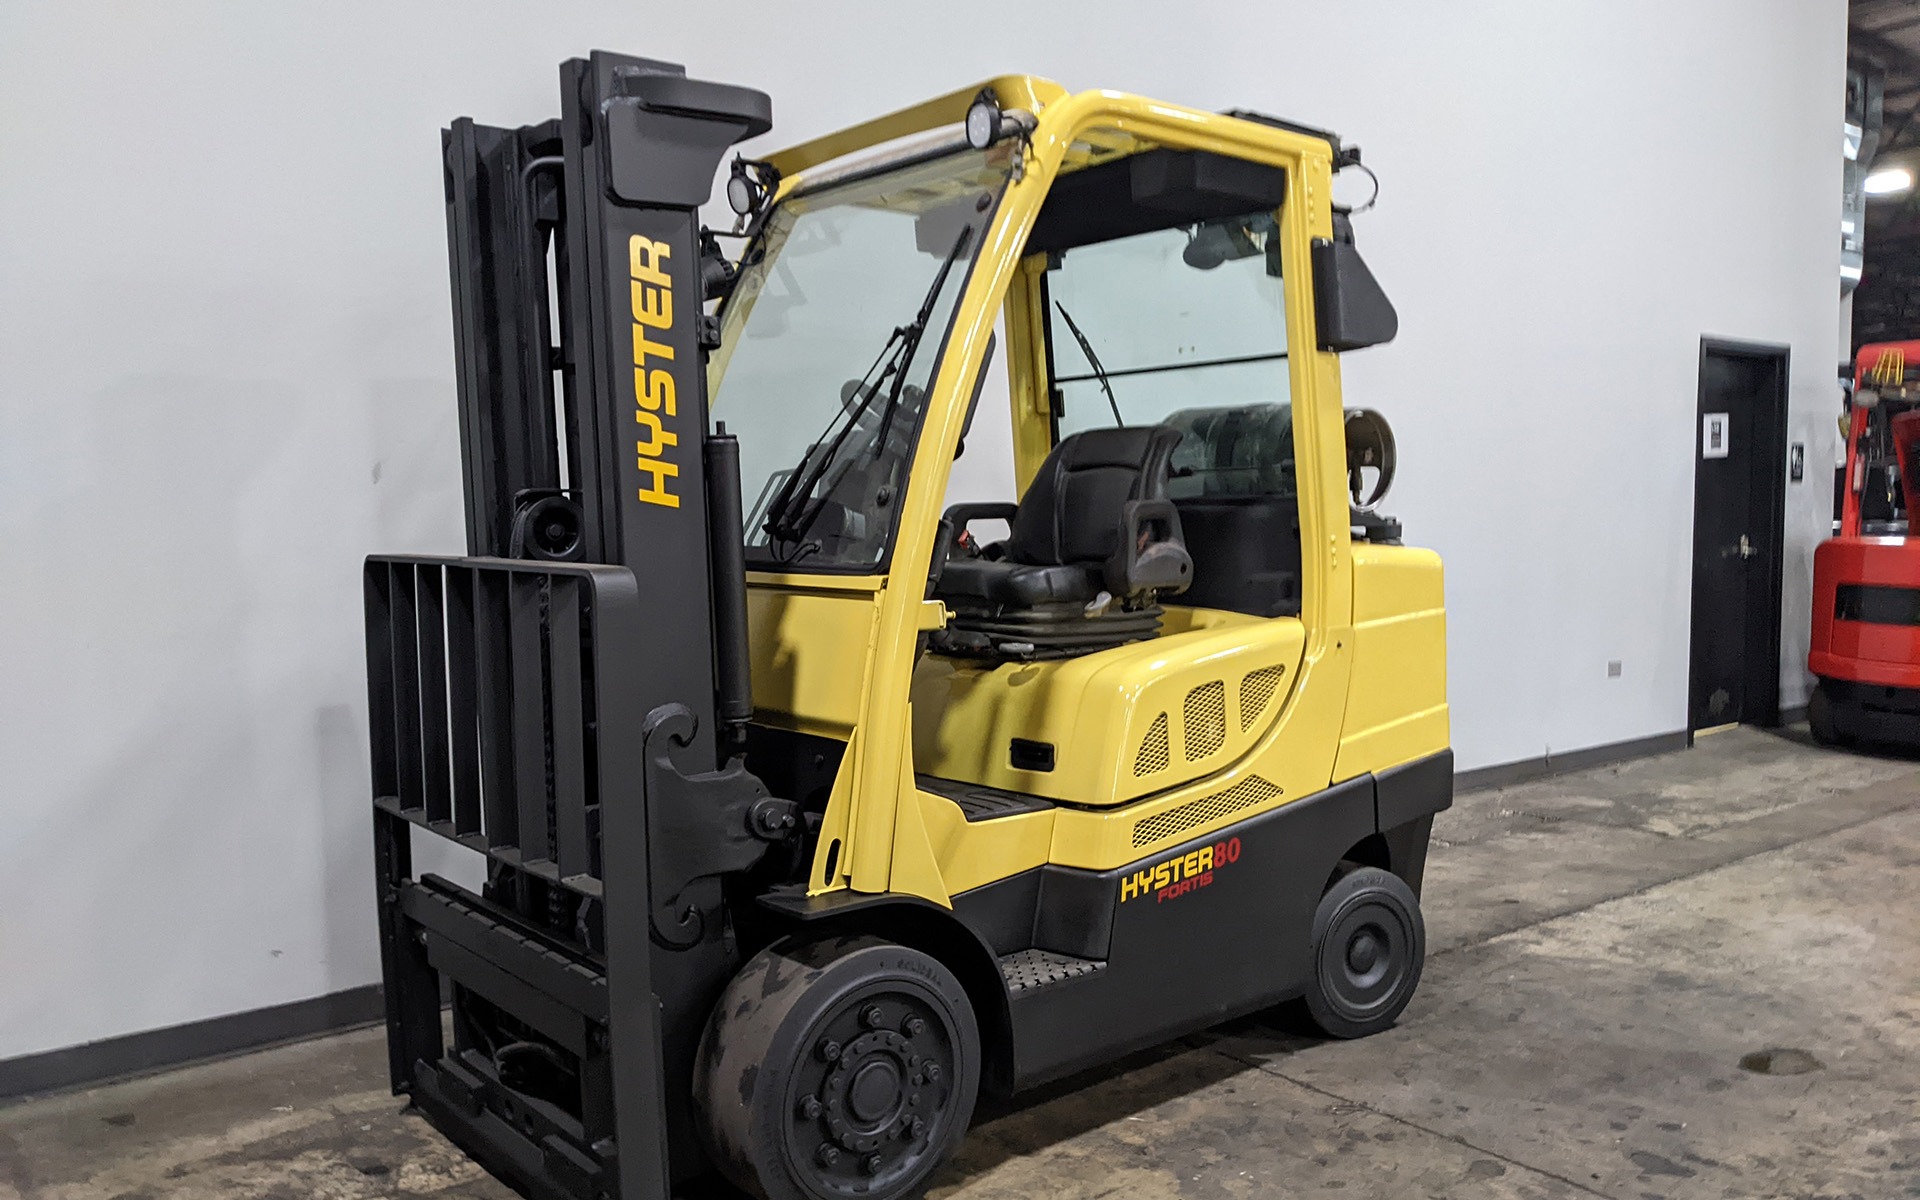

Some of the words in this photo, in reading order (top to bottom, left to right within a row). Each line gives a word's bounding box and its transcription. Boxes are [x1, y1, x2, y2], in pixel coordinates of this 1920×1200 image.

[629, 234, 680, 508] HYSTER
[1120, 846, 1214, 903] HYSTER
[1214, 837, 1241, 868] 80
[1157, 870, 1214, 903] FORTIS
